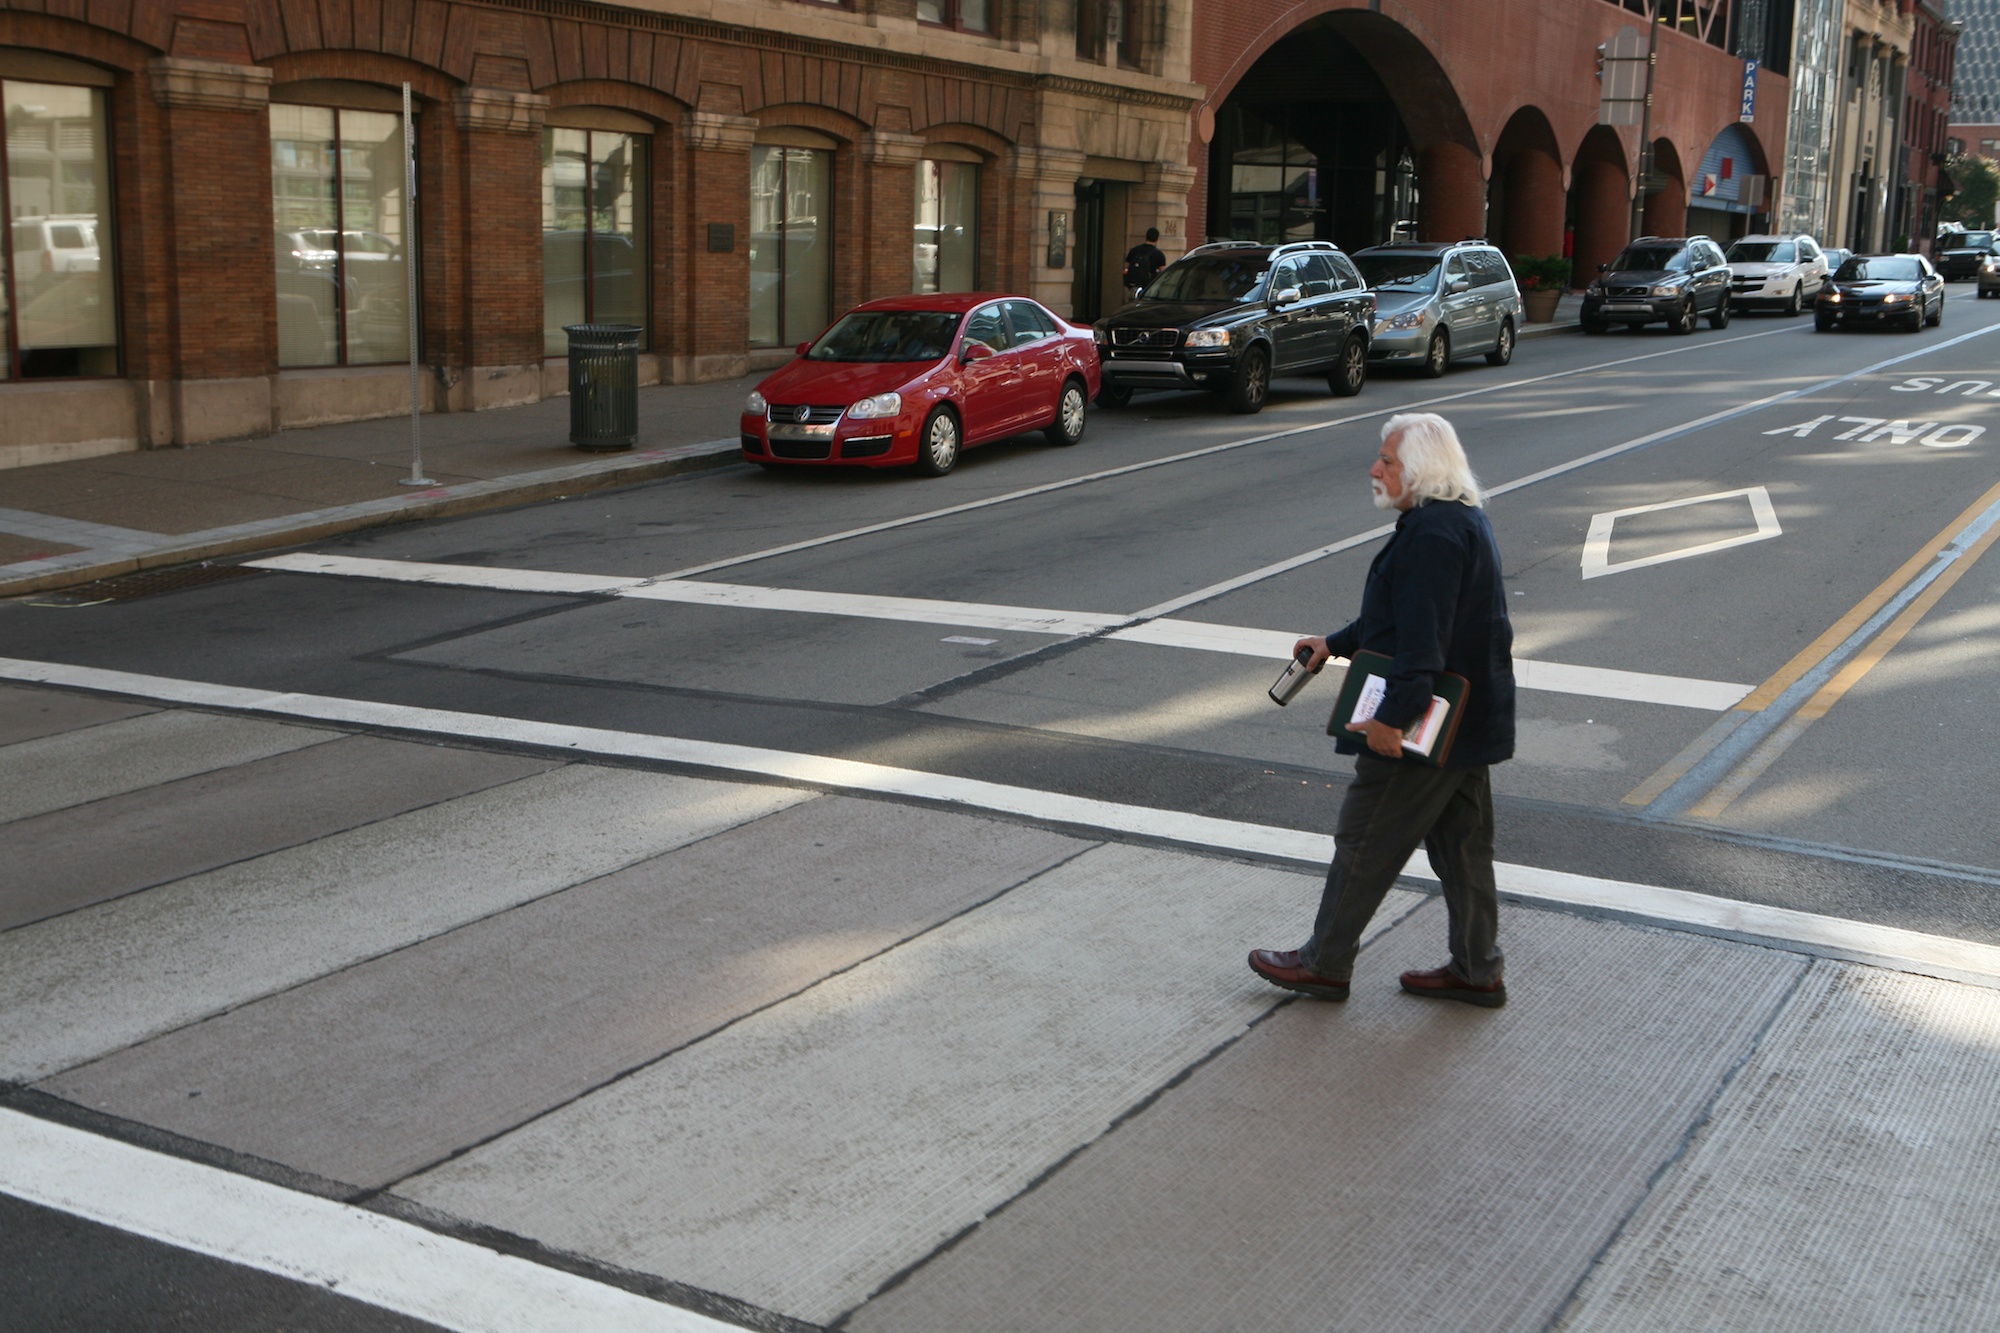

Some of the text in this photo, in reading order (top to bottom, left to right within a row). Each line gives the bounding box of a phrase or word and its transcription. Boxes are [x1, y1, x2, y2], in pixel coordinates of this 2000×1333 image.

[1742, 62, 1756, 115] PARK
[1890, 377, 2000, 397] US
[1762, 414, 1987, 448] ONLY
